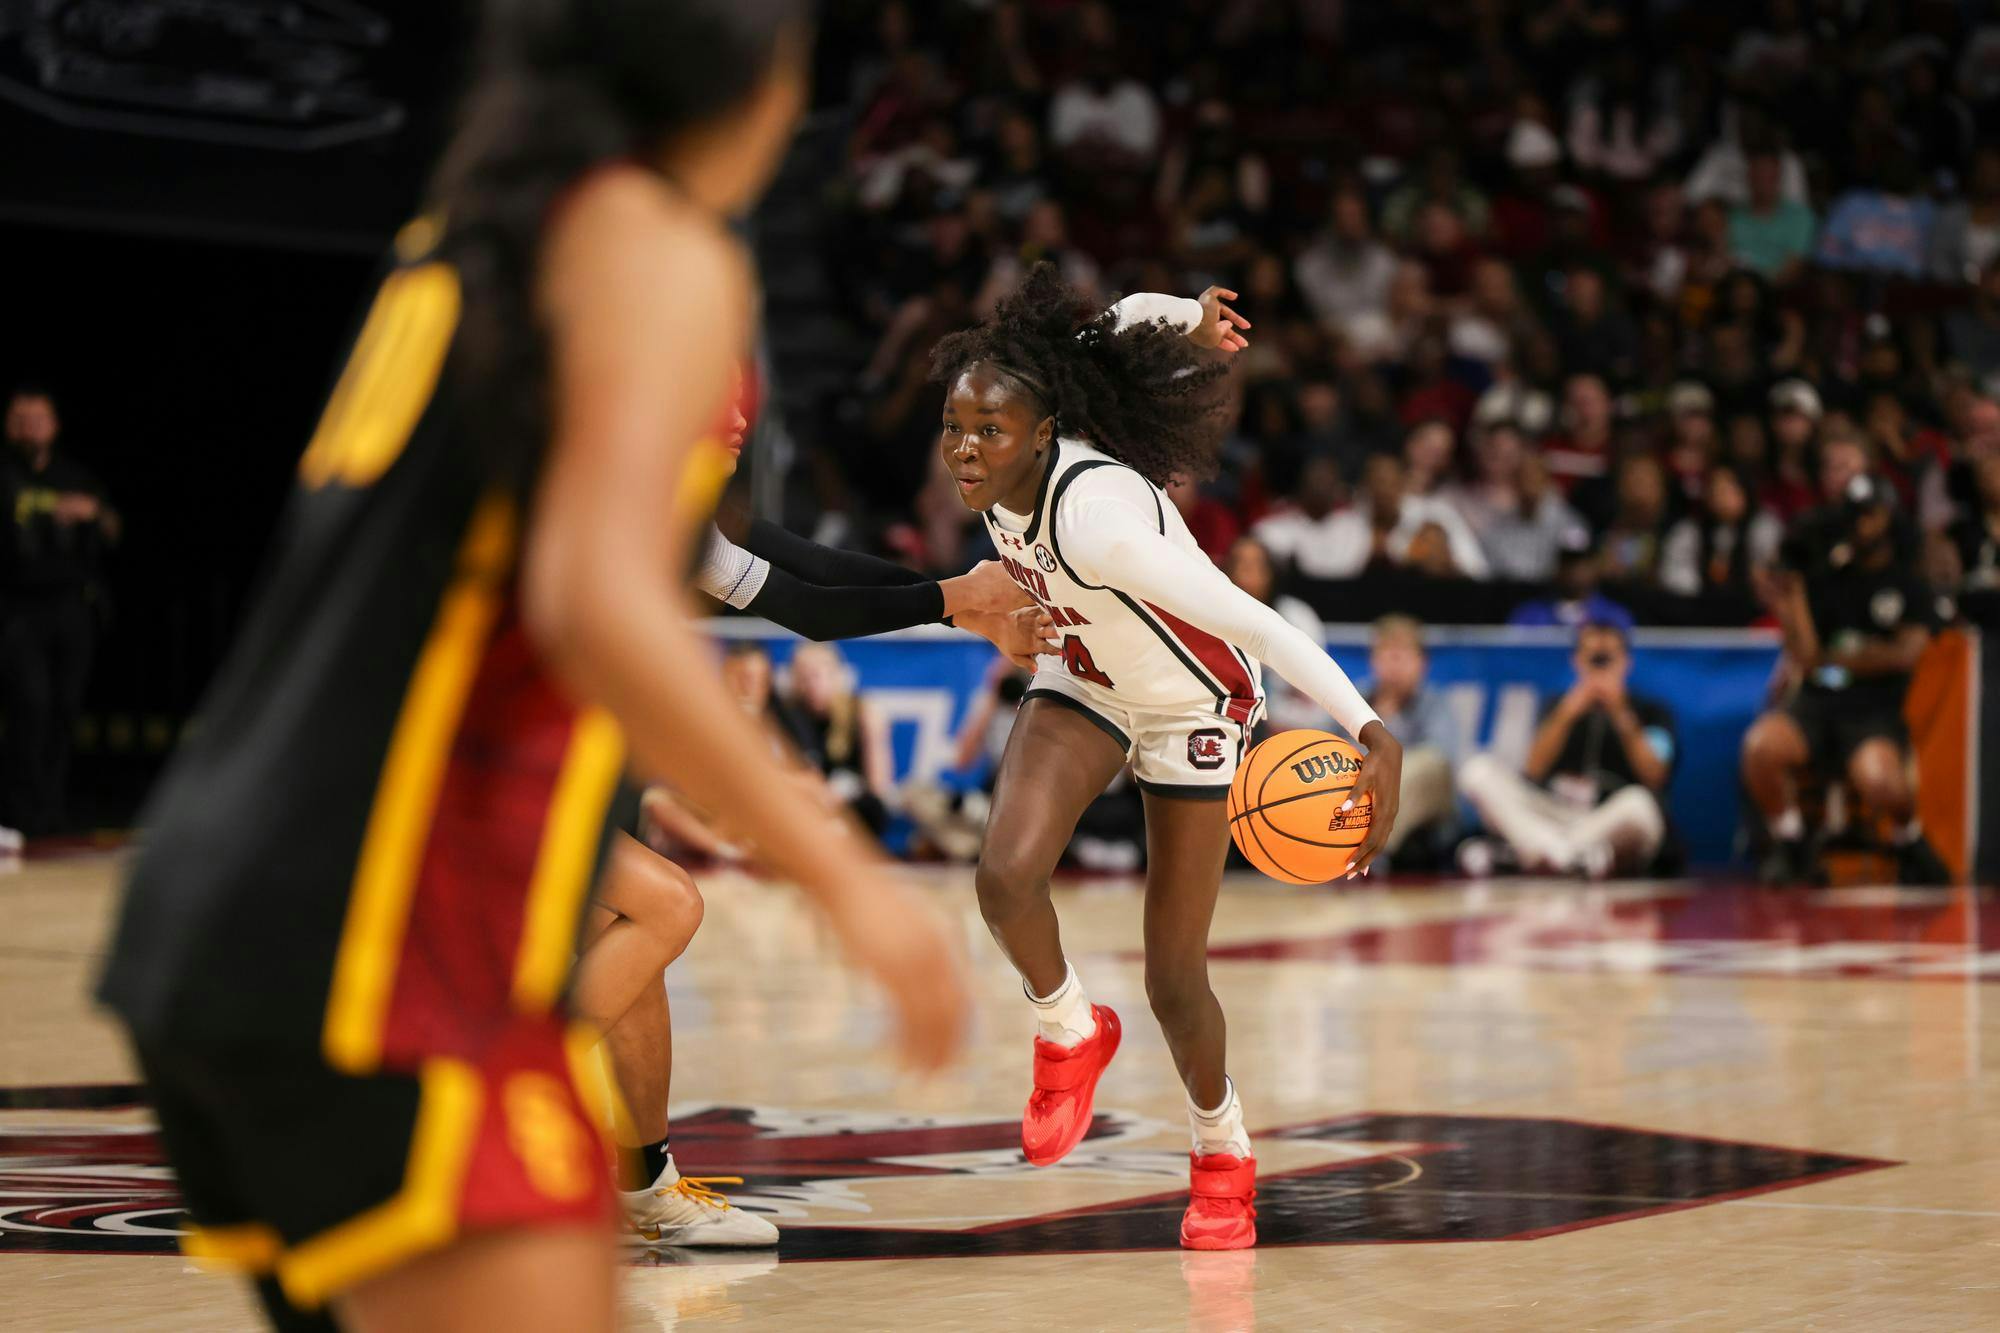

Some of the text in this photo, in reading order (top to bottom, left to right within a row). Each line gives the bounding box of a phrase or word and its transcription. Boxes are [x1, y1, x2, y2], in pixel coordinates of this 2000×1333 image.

[1001, 554, 1051, 601] OUTH
[1062, 634, 1115, 690] 4
[1290, 751, 1363, 784] Wilso
[1344, 815, 1371, 827] MADNES
